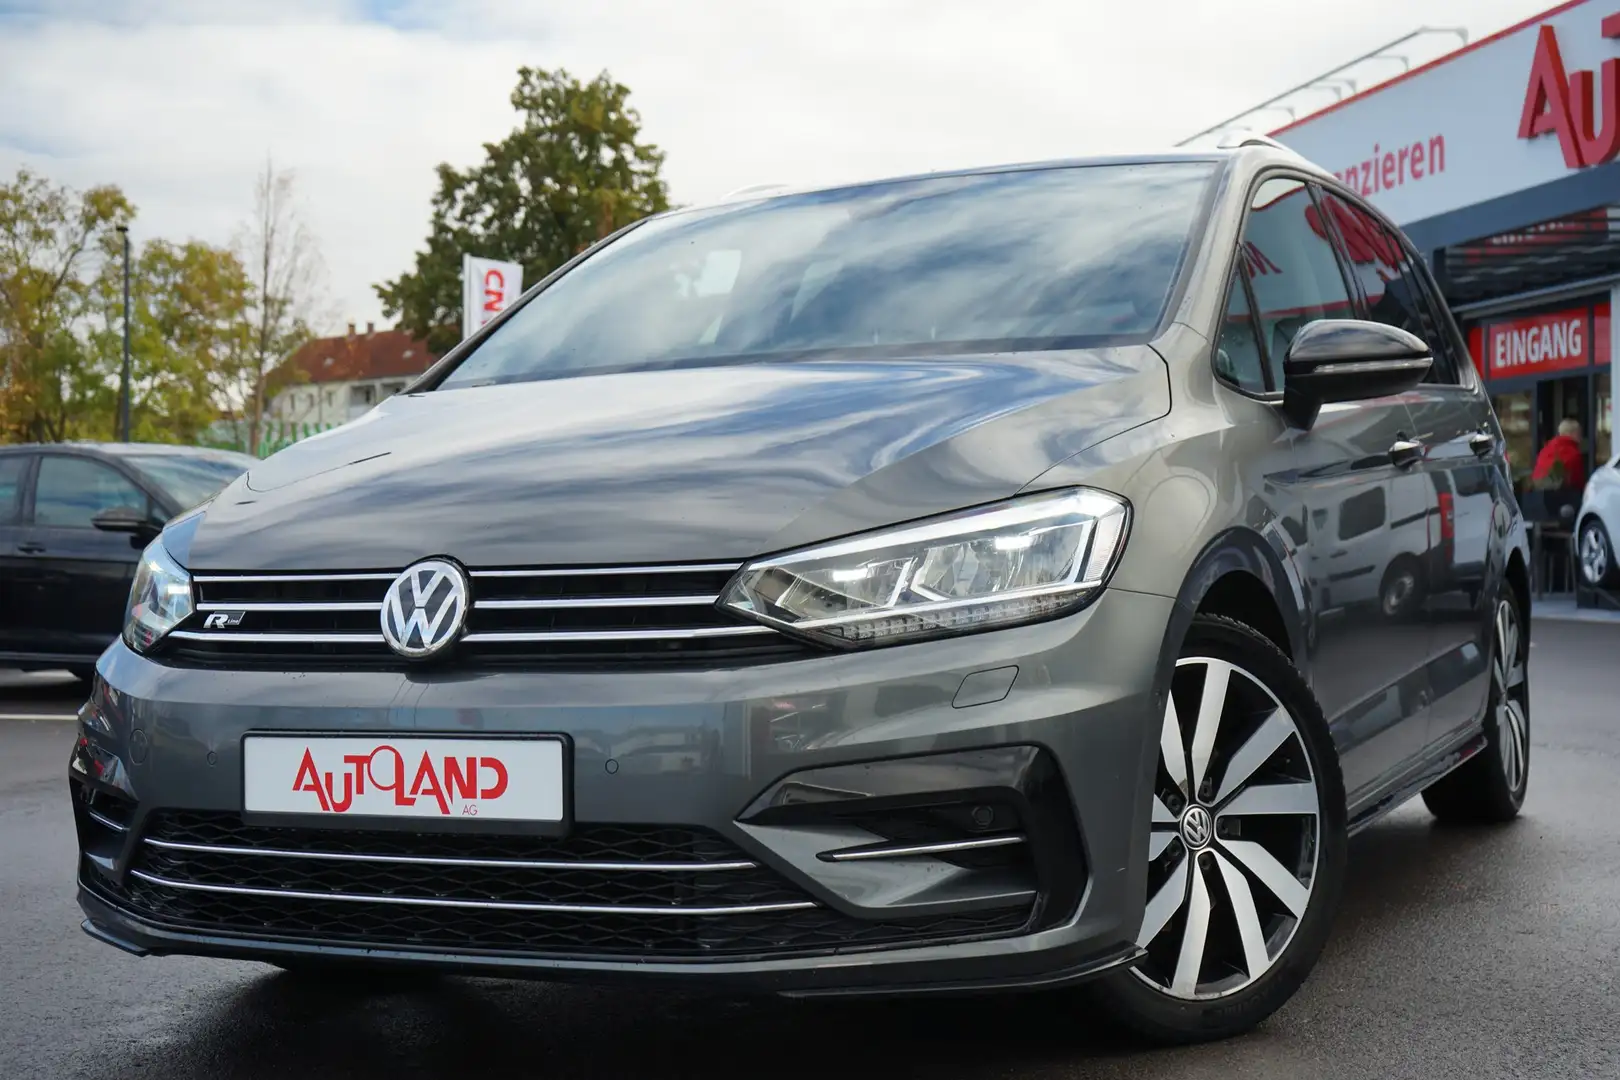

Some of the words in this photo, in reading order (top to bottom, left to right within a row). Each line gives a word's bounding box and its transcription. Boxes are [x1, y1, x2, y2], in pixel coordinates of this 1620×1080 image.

[1495, 319, 1582, 369] EINGANG
[292, 745, 508, 815] AUTOLAND
[462, 804, 478, 816] AG
